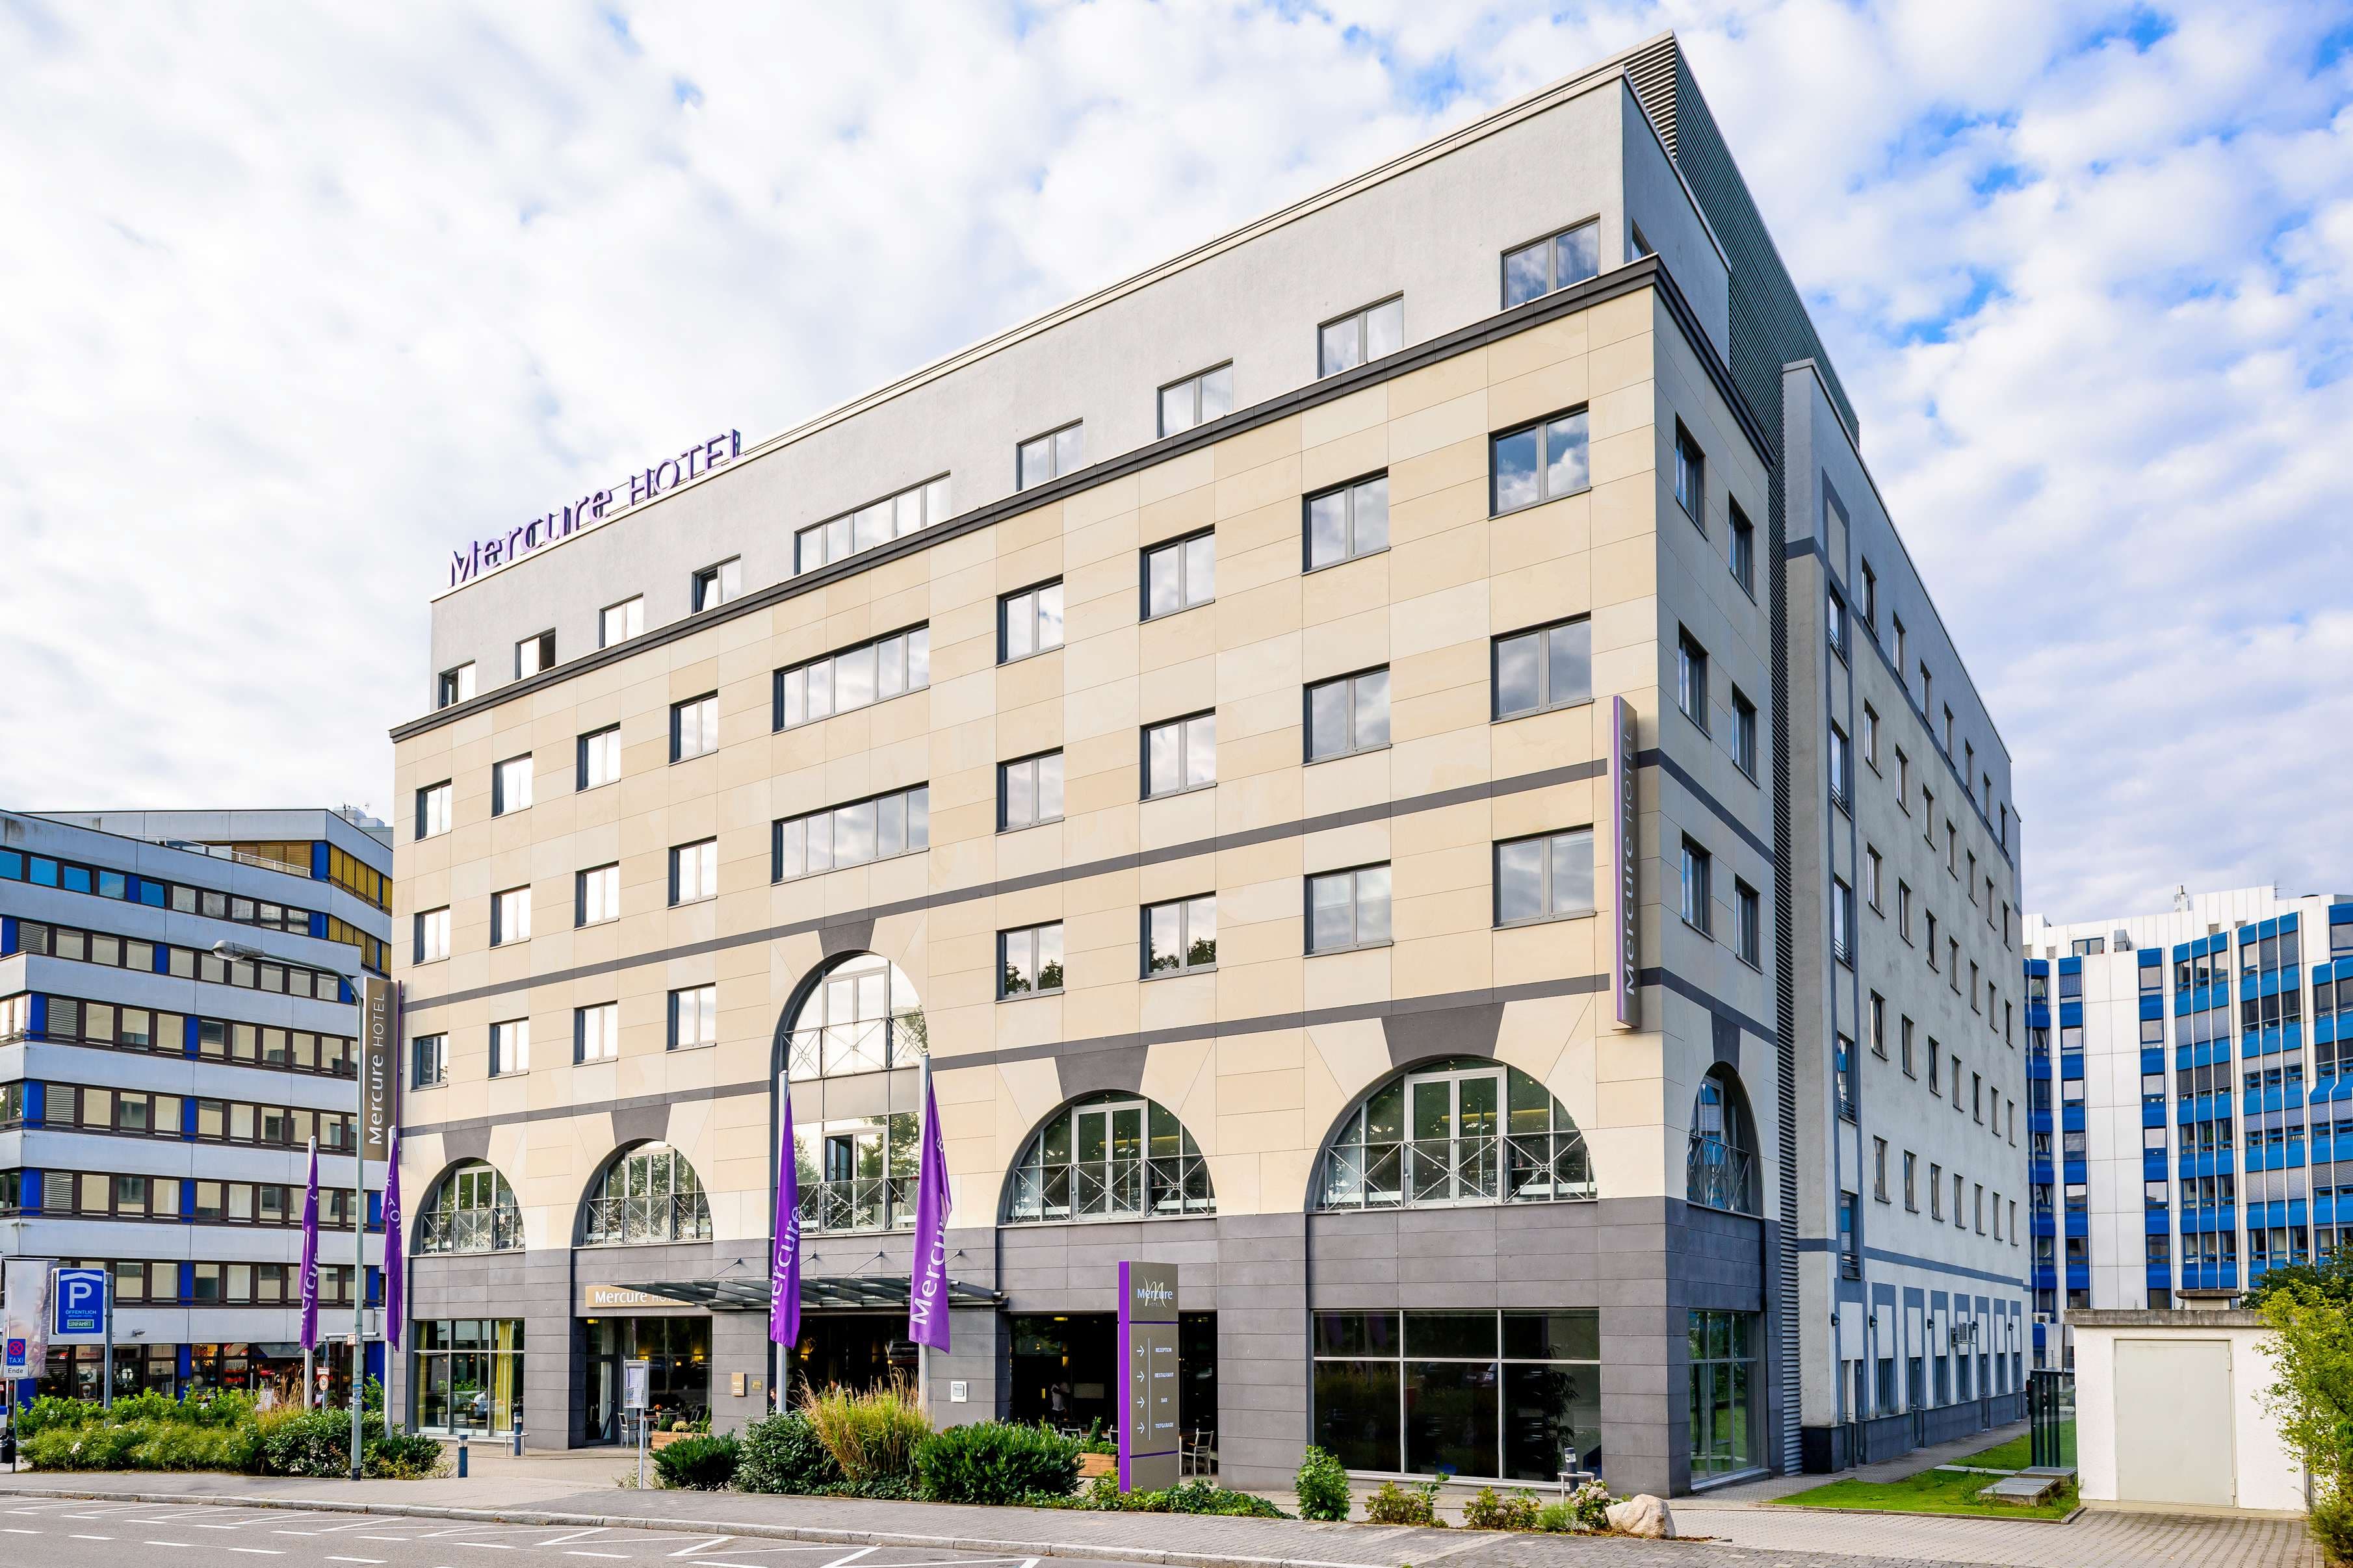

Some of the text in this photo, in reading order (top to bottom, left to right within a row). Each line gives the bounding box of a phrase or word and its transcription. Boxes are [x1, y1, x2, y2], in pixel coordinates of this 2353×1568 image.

[447, 428, 746, 588] Mercure HOTEL
[1626, 836, 1634, 995] Mercure
[369, 993, 385, 1145] Mercure HOTEL
[69, 1282, 92, 1309] P
[595, 1291, 649, 1304] Mercure
[1137, 1289, 1173, 1300] Mercure
